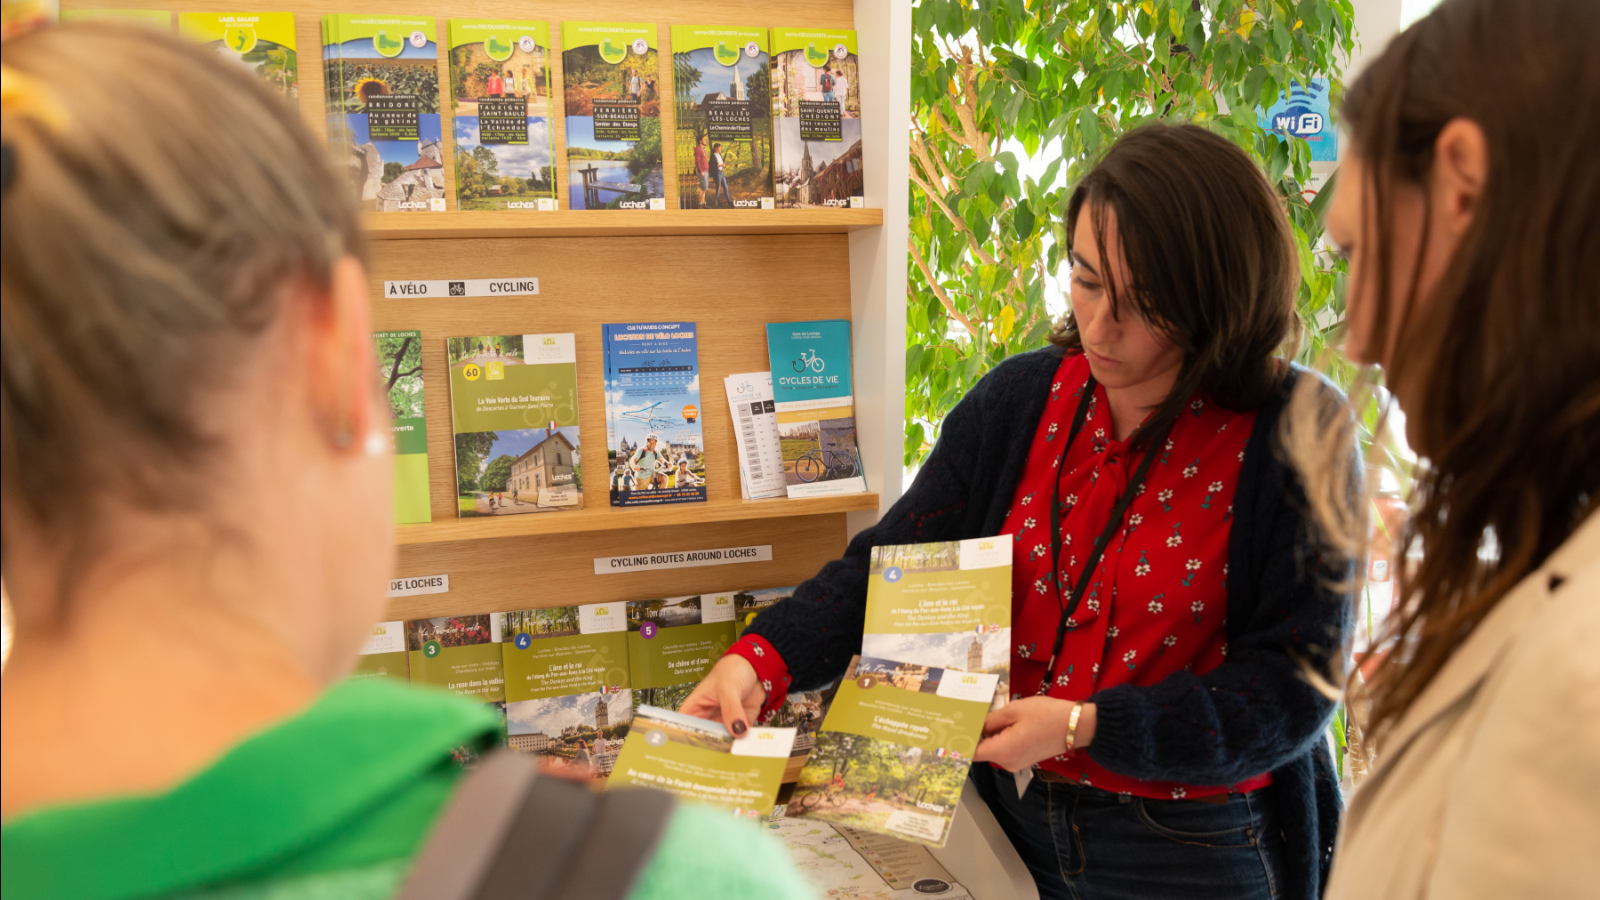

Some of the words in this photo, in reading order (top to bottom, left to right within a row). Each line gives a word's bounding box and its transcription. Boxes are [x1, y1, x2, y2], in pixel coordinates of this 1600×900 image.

[390, 282, 397, 295] À
[399, 282, 427, 294] VÉLO
[490, 282, 534, 293] CYCLING
[466, 368, 478, 377] 60
[779, 376, 811, 385] CYCLES
[610, 557, 648, 568] CYCLING
[650, 554, 684, 565] ROUTES
[686, 550, 722, 562] AROUND
[724, 548, 756, 558] LOCHES
[889, 570, 896, 580] 4
[390, 580, 403, 591] DE
[405, 577, 443, 590] LOCHES
[646, 626, 652, 635] 5
[520, 637, 527, 646] 4
[428, 645, 436, 655] 3
[864, 678, 870, 687] 1
[874, 715, 908, 729] L'échappée
[909, 724, 929, 733] royale
[650, 733, 661, 744] 2
[656, 774, 665, 783] de
[666, 776, 673, 785] la
